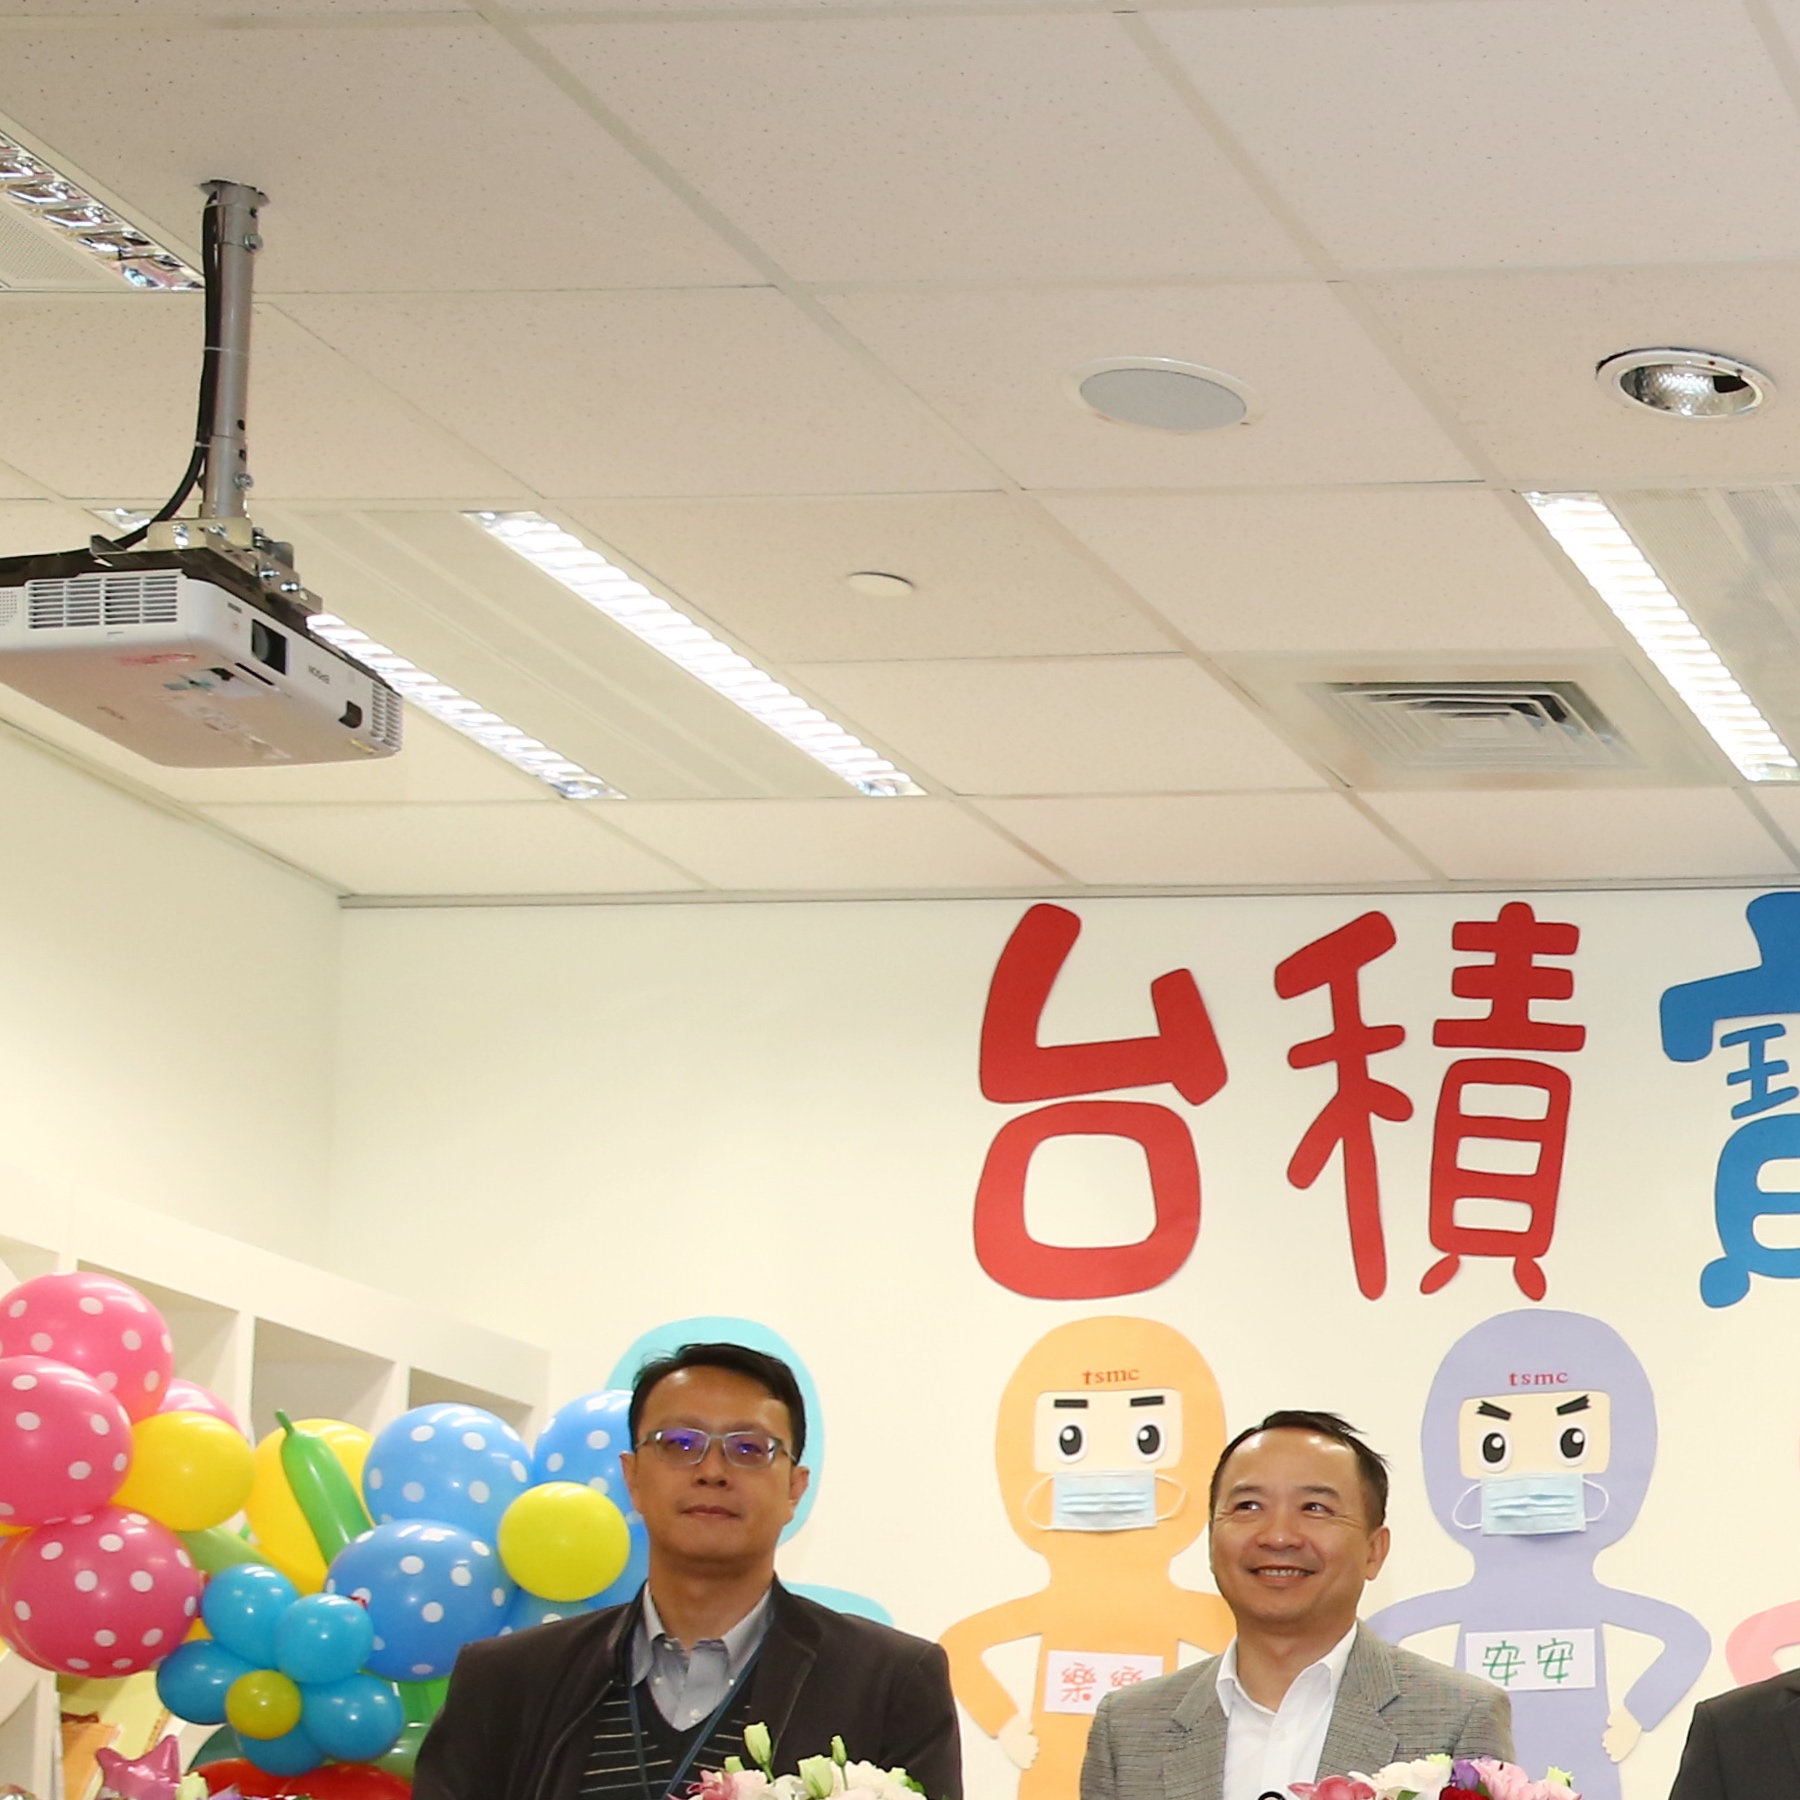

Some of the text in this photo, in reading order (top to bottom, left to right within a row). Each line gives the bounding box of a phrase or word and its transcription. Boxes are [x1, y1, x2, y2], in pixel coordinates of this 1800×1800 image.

[1082, 1368, 1140, 1386] tsmc
[1508, 1371, 1569, 1387] tsmc
[1482, 1637, 1574, 1687] 安安
